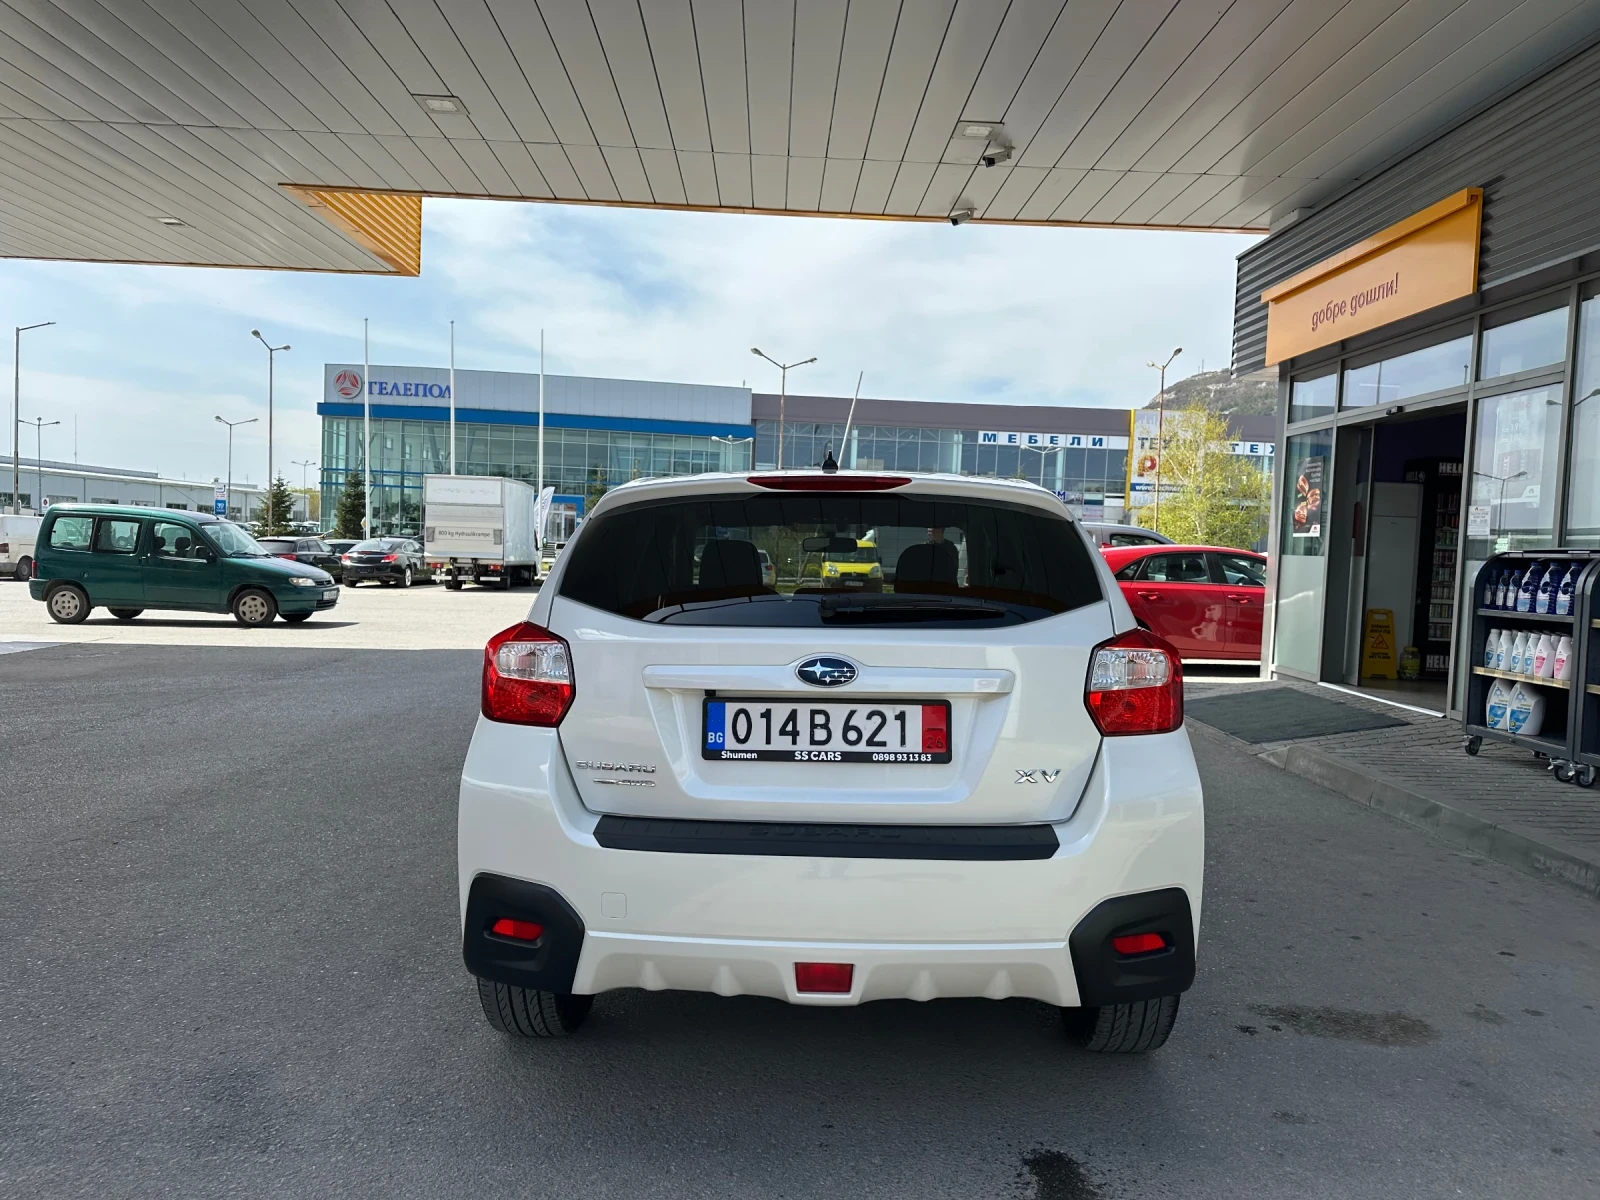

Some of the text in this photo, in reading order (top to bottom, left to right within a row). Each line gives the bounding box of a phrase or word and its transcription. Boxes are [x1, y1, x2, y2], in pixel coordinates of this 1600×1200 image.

[1311, 272, 1399, 332] добре дошли!
[982, 433, 1103, 447] МЕБЕЛИ
[707, 732, 724, 744] BG
[721, 750, 932, 762] Shumen SS CARS 0898 93 13 83
[575, 760, 656, 774] SUBARU
[1014, 768, 1062, 784] XV
[748, 825, 902, 839] SUBARU
